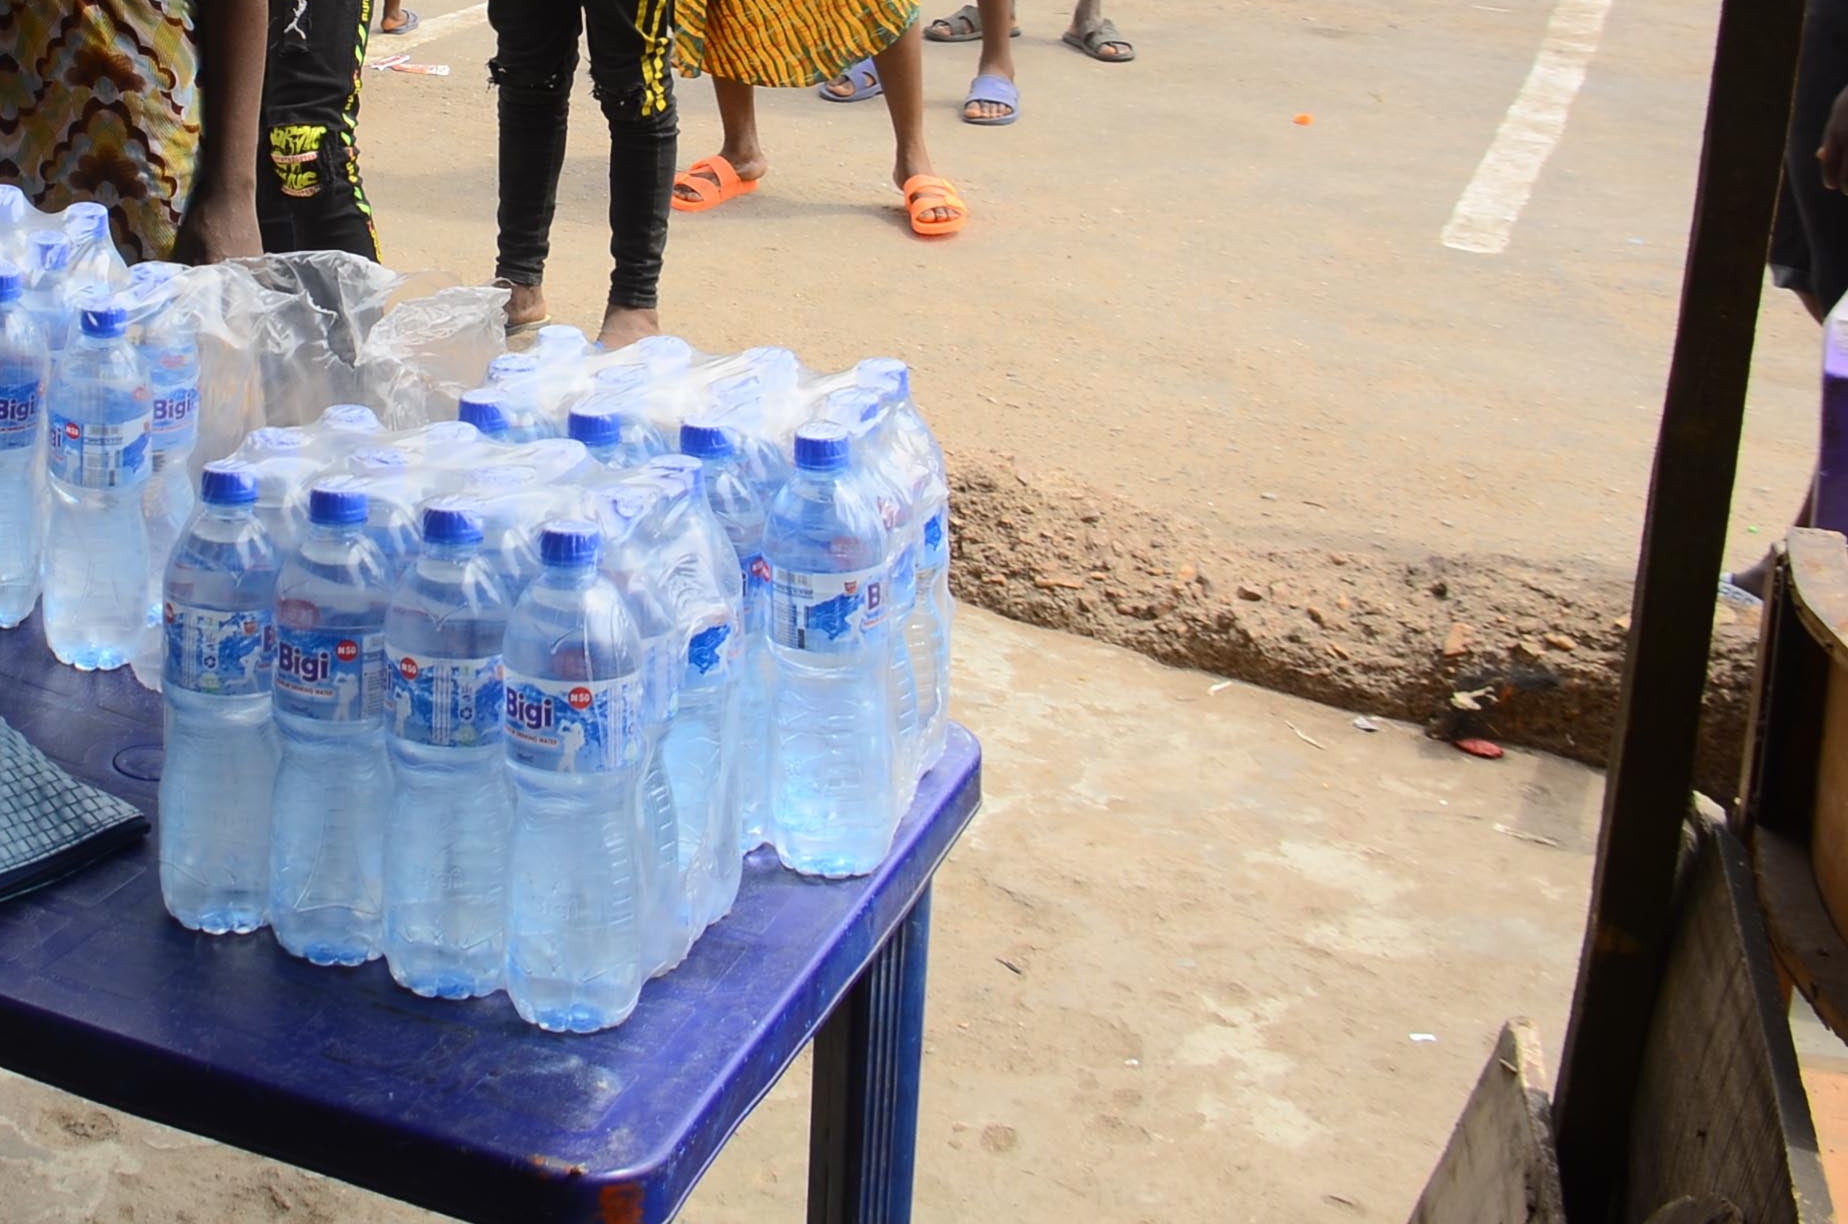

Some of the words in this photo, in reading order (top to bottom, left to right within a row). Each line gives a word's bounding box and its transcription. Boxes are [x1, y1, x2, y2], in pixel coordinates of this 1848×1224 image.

[153, 393, 192, 421] Bigi
[277, 641, 330, 682] Bigi
[506, 685, 553, 729] Bigi
